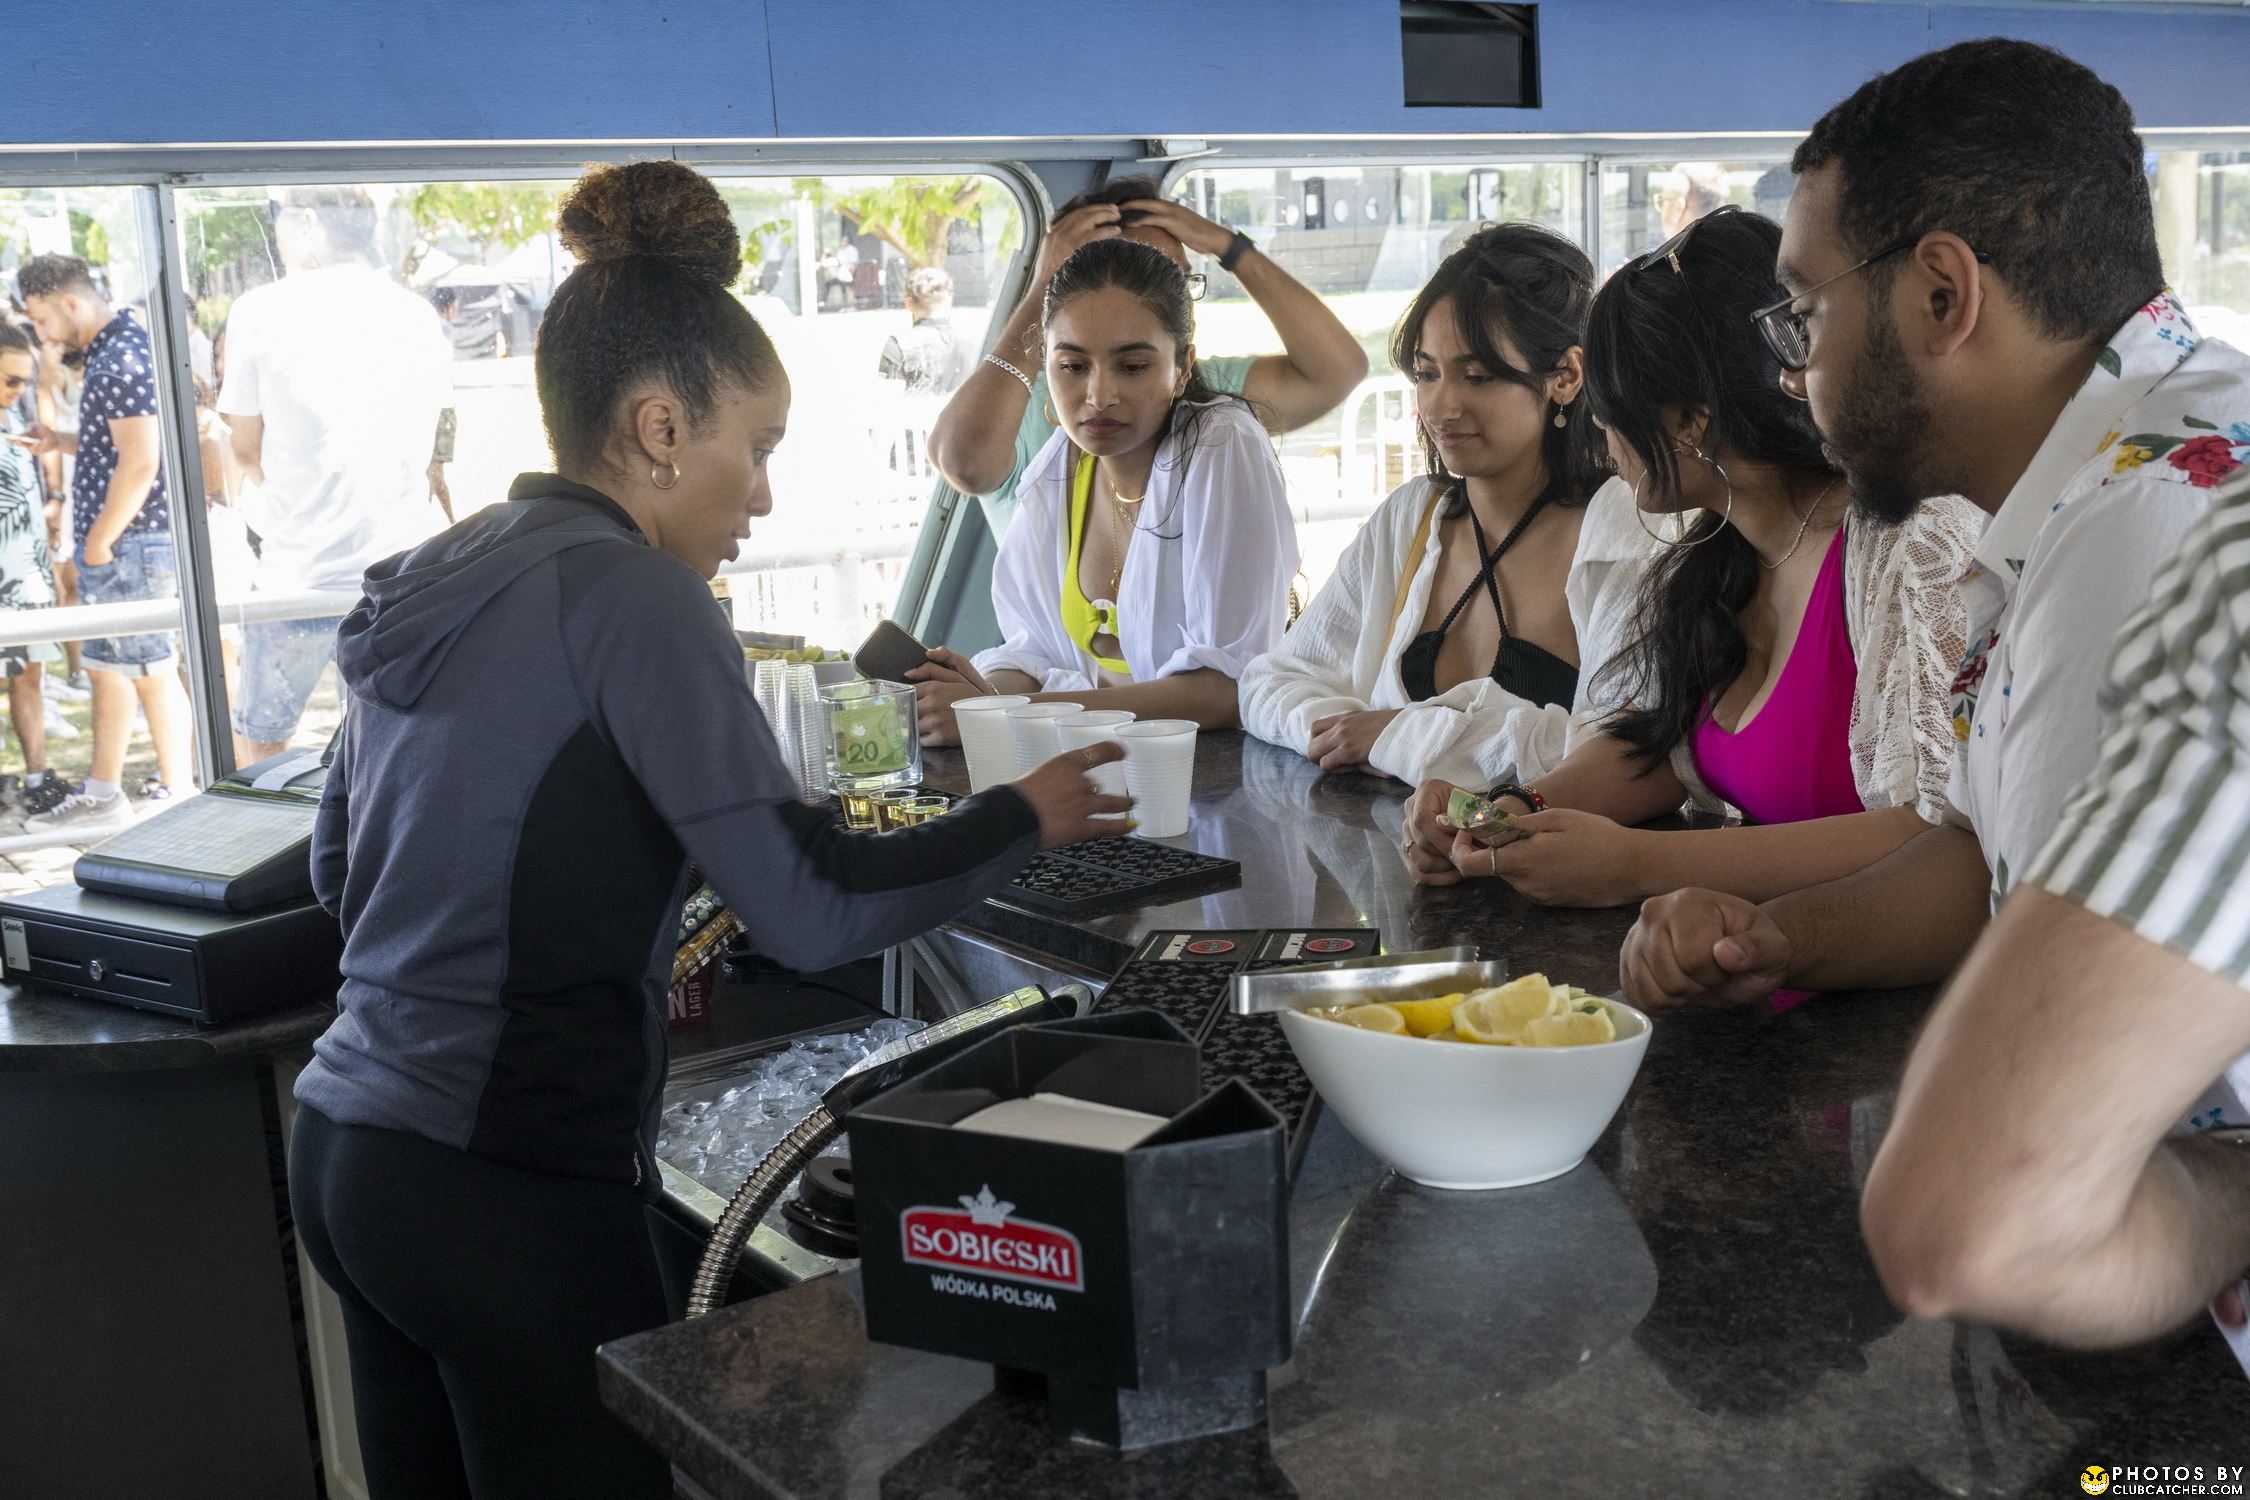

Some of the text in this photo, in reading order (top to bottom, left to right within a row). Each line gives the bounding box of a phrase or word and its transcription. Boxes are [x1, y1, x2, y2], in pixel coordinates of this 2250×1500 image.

[847, 740, 879, 764] 20
[688, 982, 702, 1017] LAGER
[910, 1223, 1072, 1277] SOBIESKI
[930, 1273, 1057, 1312] WÓDKA POLSKA
